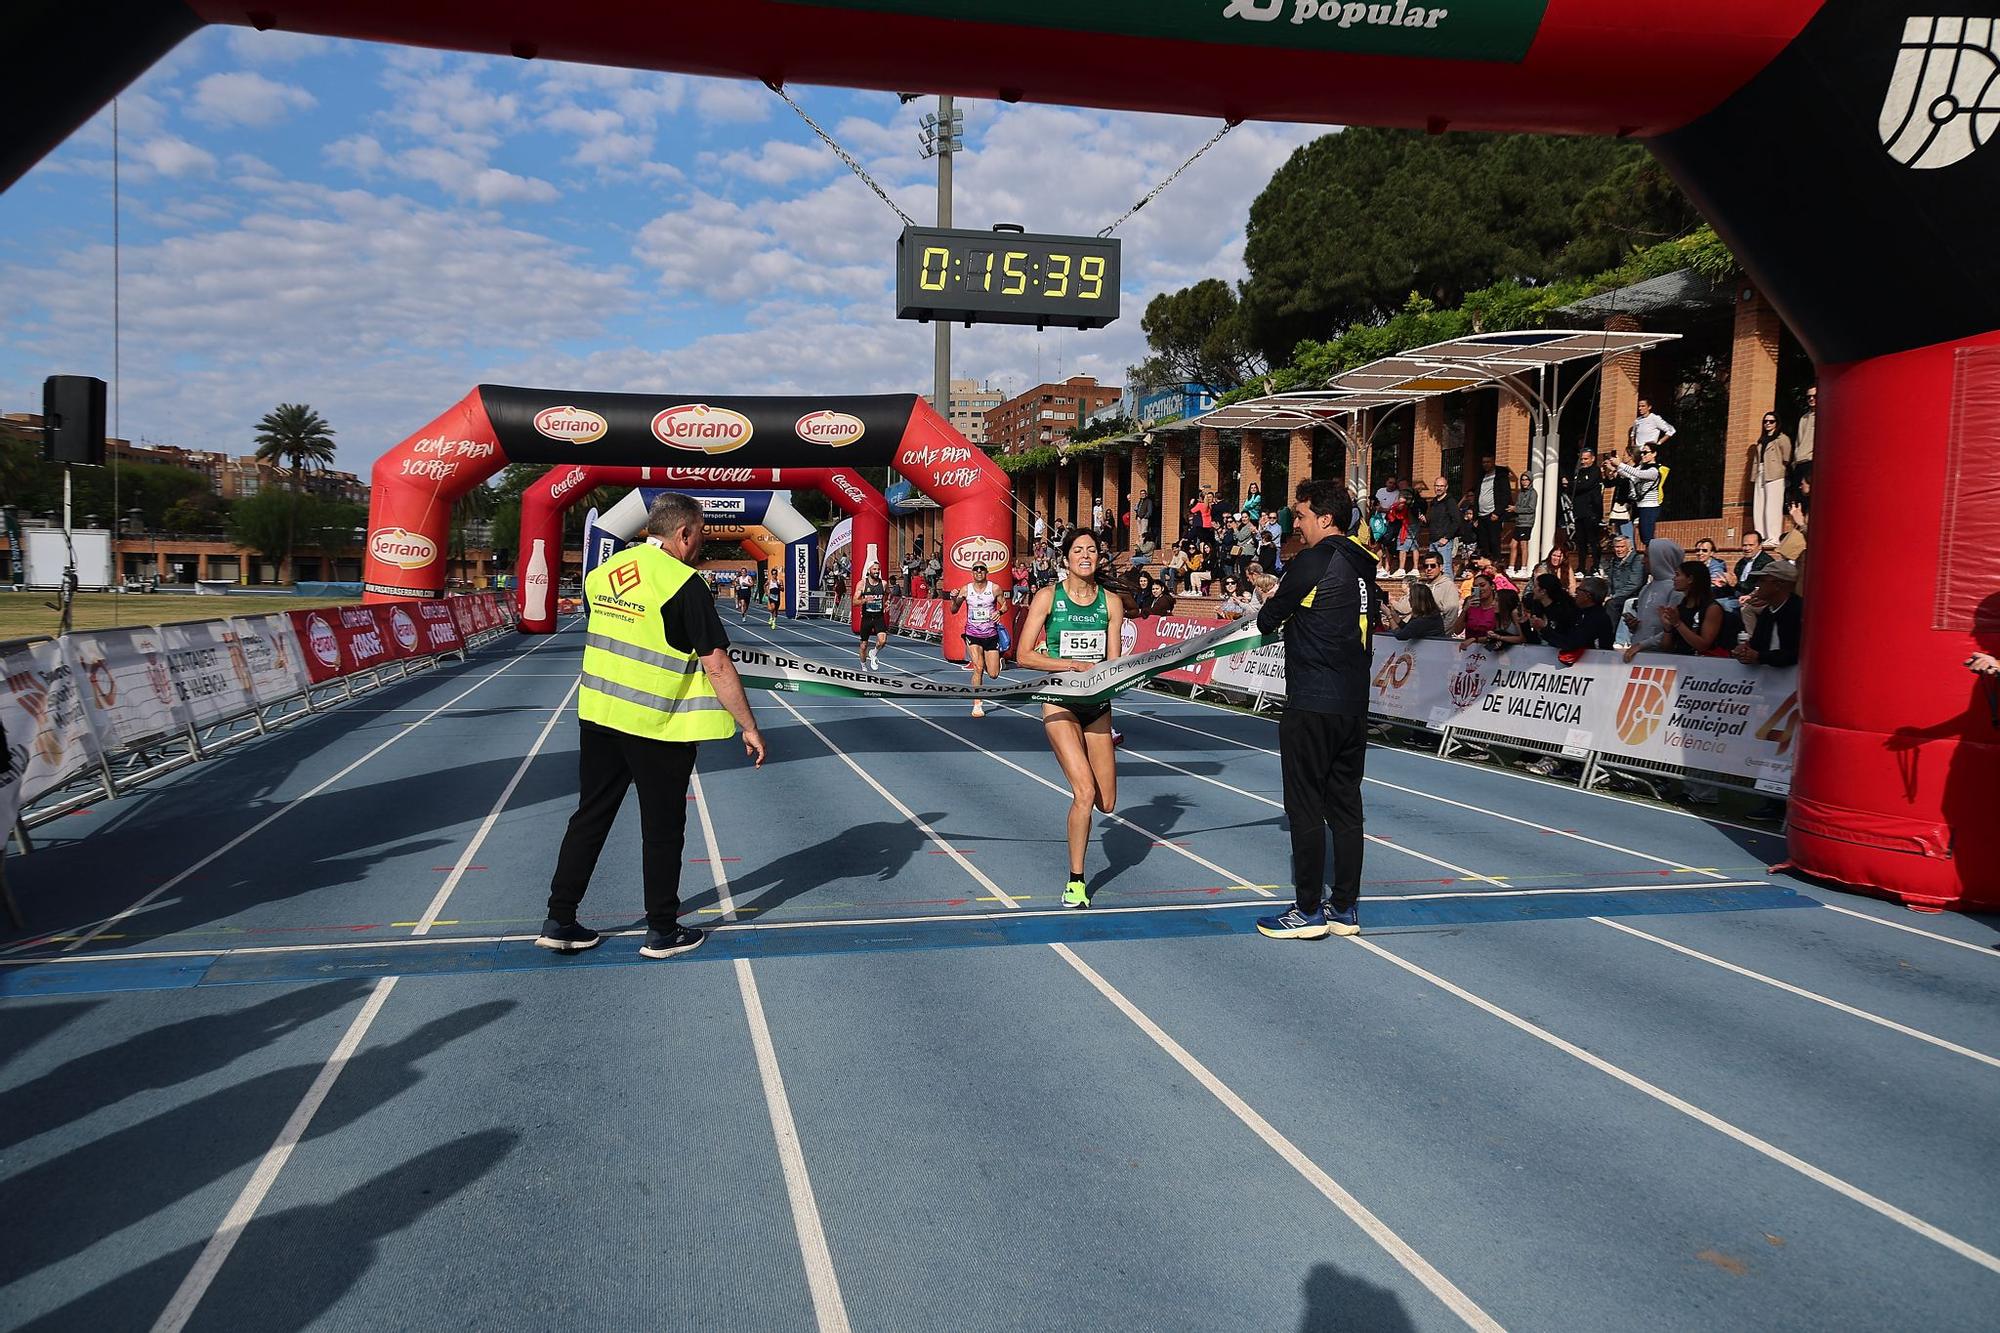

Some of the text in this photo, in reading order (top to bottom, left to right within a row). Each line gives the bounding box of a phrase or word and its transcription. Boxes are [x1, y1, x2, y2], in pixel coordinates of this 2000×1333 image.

[1290, 0, 1448, 28] popular
[920, 247, 1105, 299] 0:15:39
[543, 415, 600, 433] Serrano
[663, 416, 743, 438] Serrano
[803, 420, 858, 436] Serrano
[375, 537, 430, 558] Serrano
[957, 546, 1006, 562] Serrano
[595, 594, 646, 612] VEREVENTS
[1156, 617, 1185, 639] Come
[1070, 638, 1097, 649] 554
[729, 649, 770, 665] CUIT
[775, 656, 799, 670] DE
[804, 663, 904, 688] CARRERES
[1070, 673, 1107, 689] CIUTAT
[1109, 664, 1124, 676] DE
[1244, 661, 1257, 674] DE
[1491, 669, 1594, 697] AJUNTAMENT
[1680, 676, 1755, 695] Fundació
[1482, 694, 1582, 724] DE VALÈNCIA
[1674, 695, 1750, 716] Esportiva
[1668, 713, 1747, 737] Municipal
[1664, 731, 1727, 753] València
